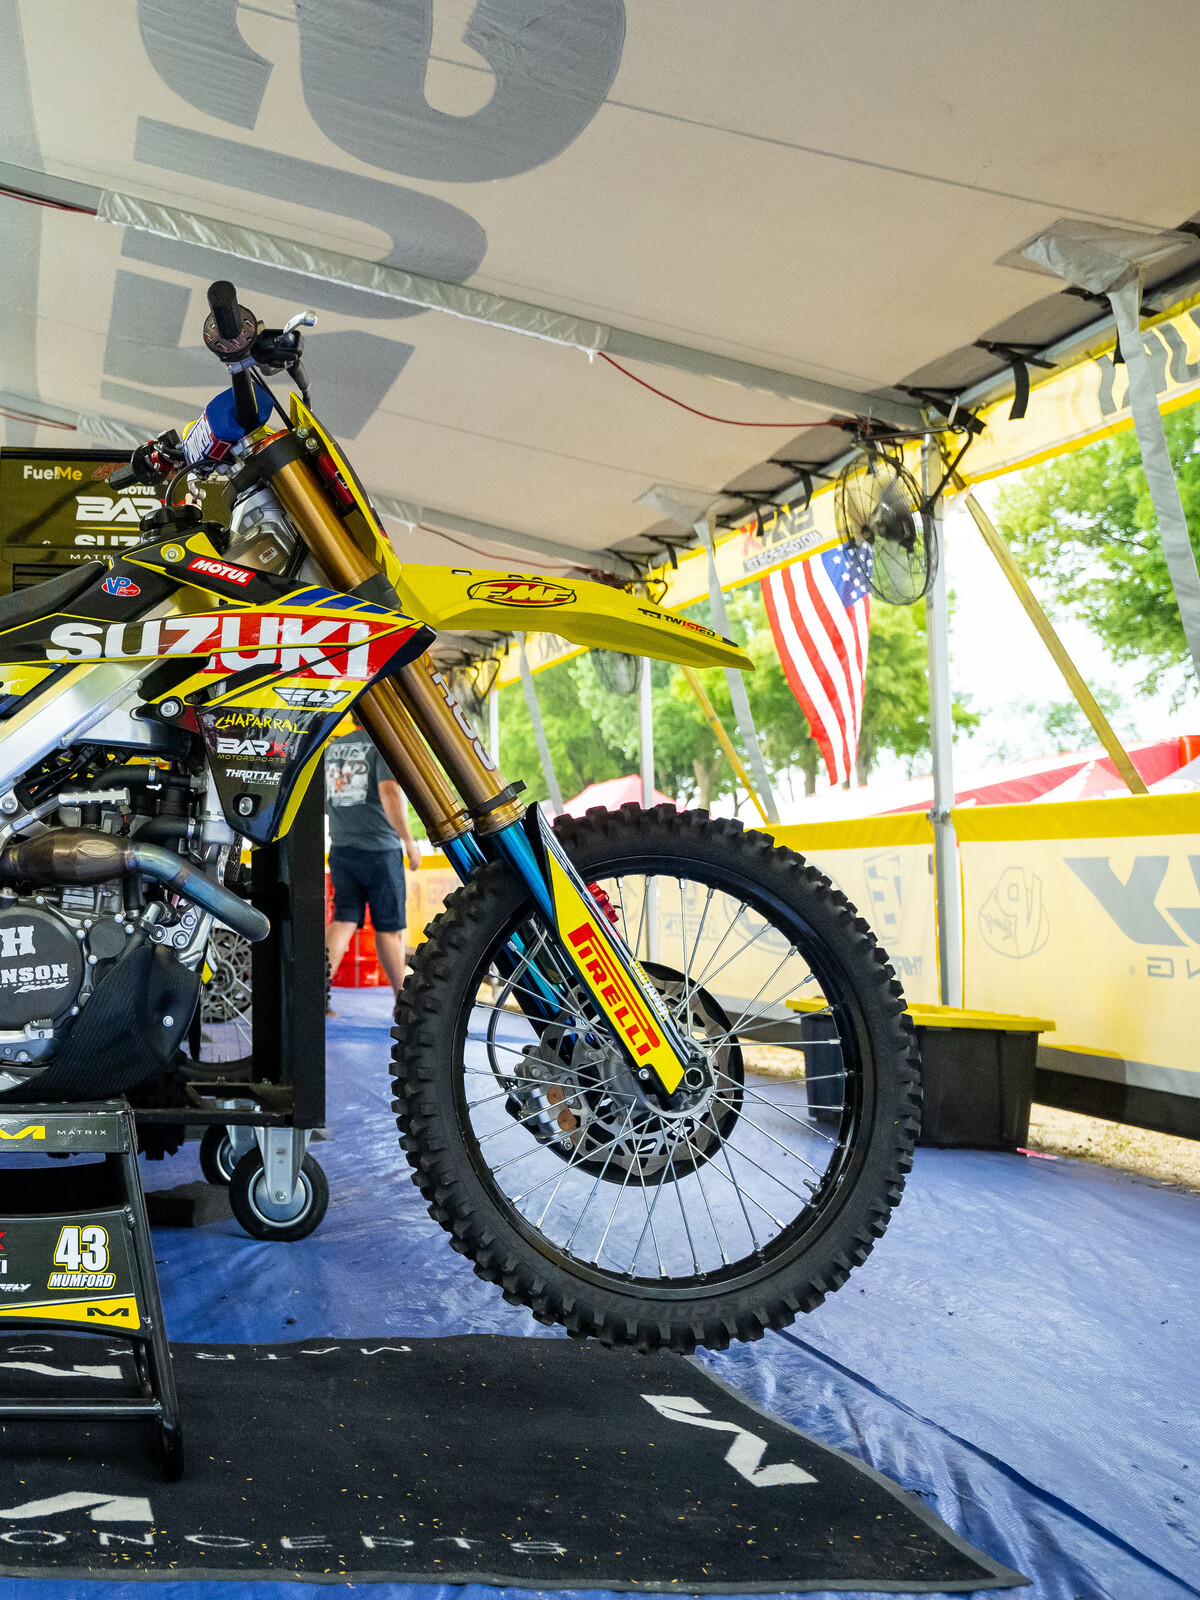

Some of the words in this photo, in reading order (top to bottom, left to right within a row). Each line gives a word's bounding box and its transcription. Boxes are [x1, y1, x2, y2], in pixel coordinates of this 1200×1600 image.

[23, 465, 83, 481] FuelMe
[75, 496, 172, 522] BAR
[191, 560, 250, 584] MOTUL
[105, 577, 131, 595] VP
[469, 583, 575, 603] FMF
[664, 615, 716, 637] TWISTED
[45, 615, 370, 681] SUZUKI
[273, 687, 351, 703] FLY
[215, 713, 308, 733] CHAPARRAL
[217, 738, 290, 757] BARX
[218, 754, 287, 763] MOTORSPORTS
[226, 769, 282, 781] THROTTLE
[567, 922, 660, 1056] PIRELLI
[54, 1226, 108, 1273] 43
[49, 1274, 114, 1288] MUMFORD
